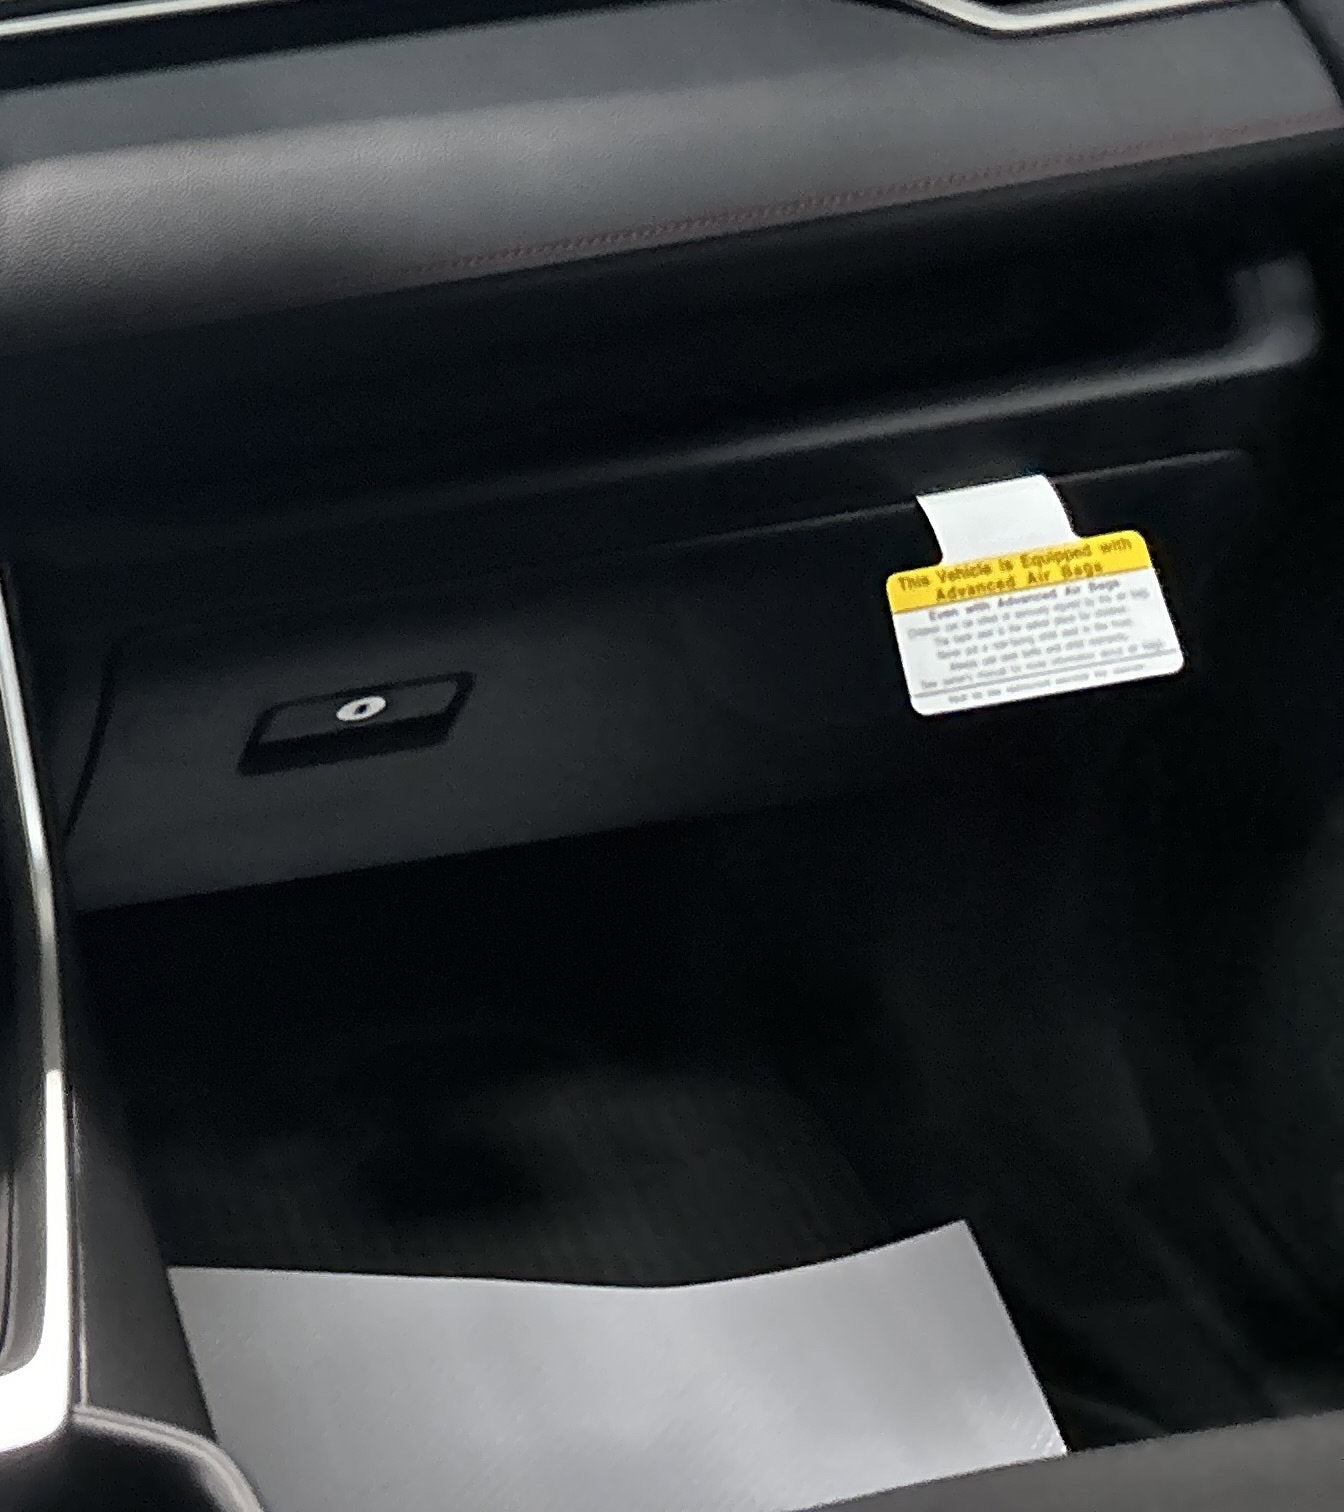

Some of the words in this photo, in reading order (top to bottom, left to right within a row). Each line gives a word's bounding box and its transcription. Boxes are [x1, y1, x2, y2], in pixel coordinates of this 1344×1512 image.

[898, 575, 931, 591] This
[936, 563, 993, 583] Vehicle
[1020, 543, 1092, 569] Equipped
[1099, 537, 1133, 553] with
[935, 576, 1017, 601] Advanced
[1027, 570, 1051, 584] Air
[1061, 562, 1104, 578] Bags
